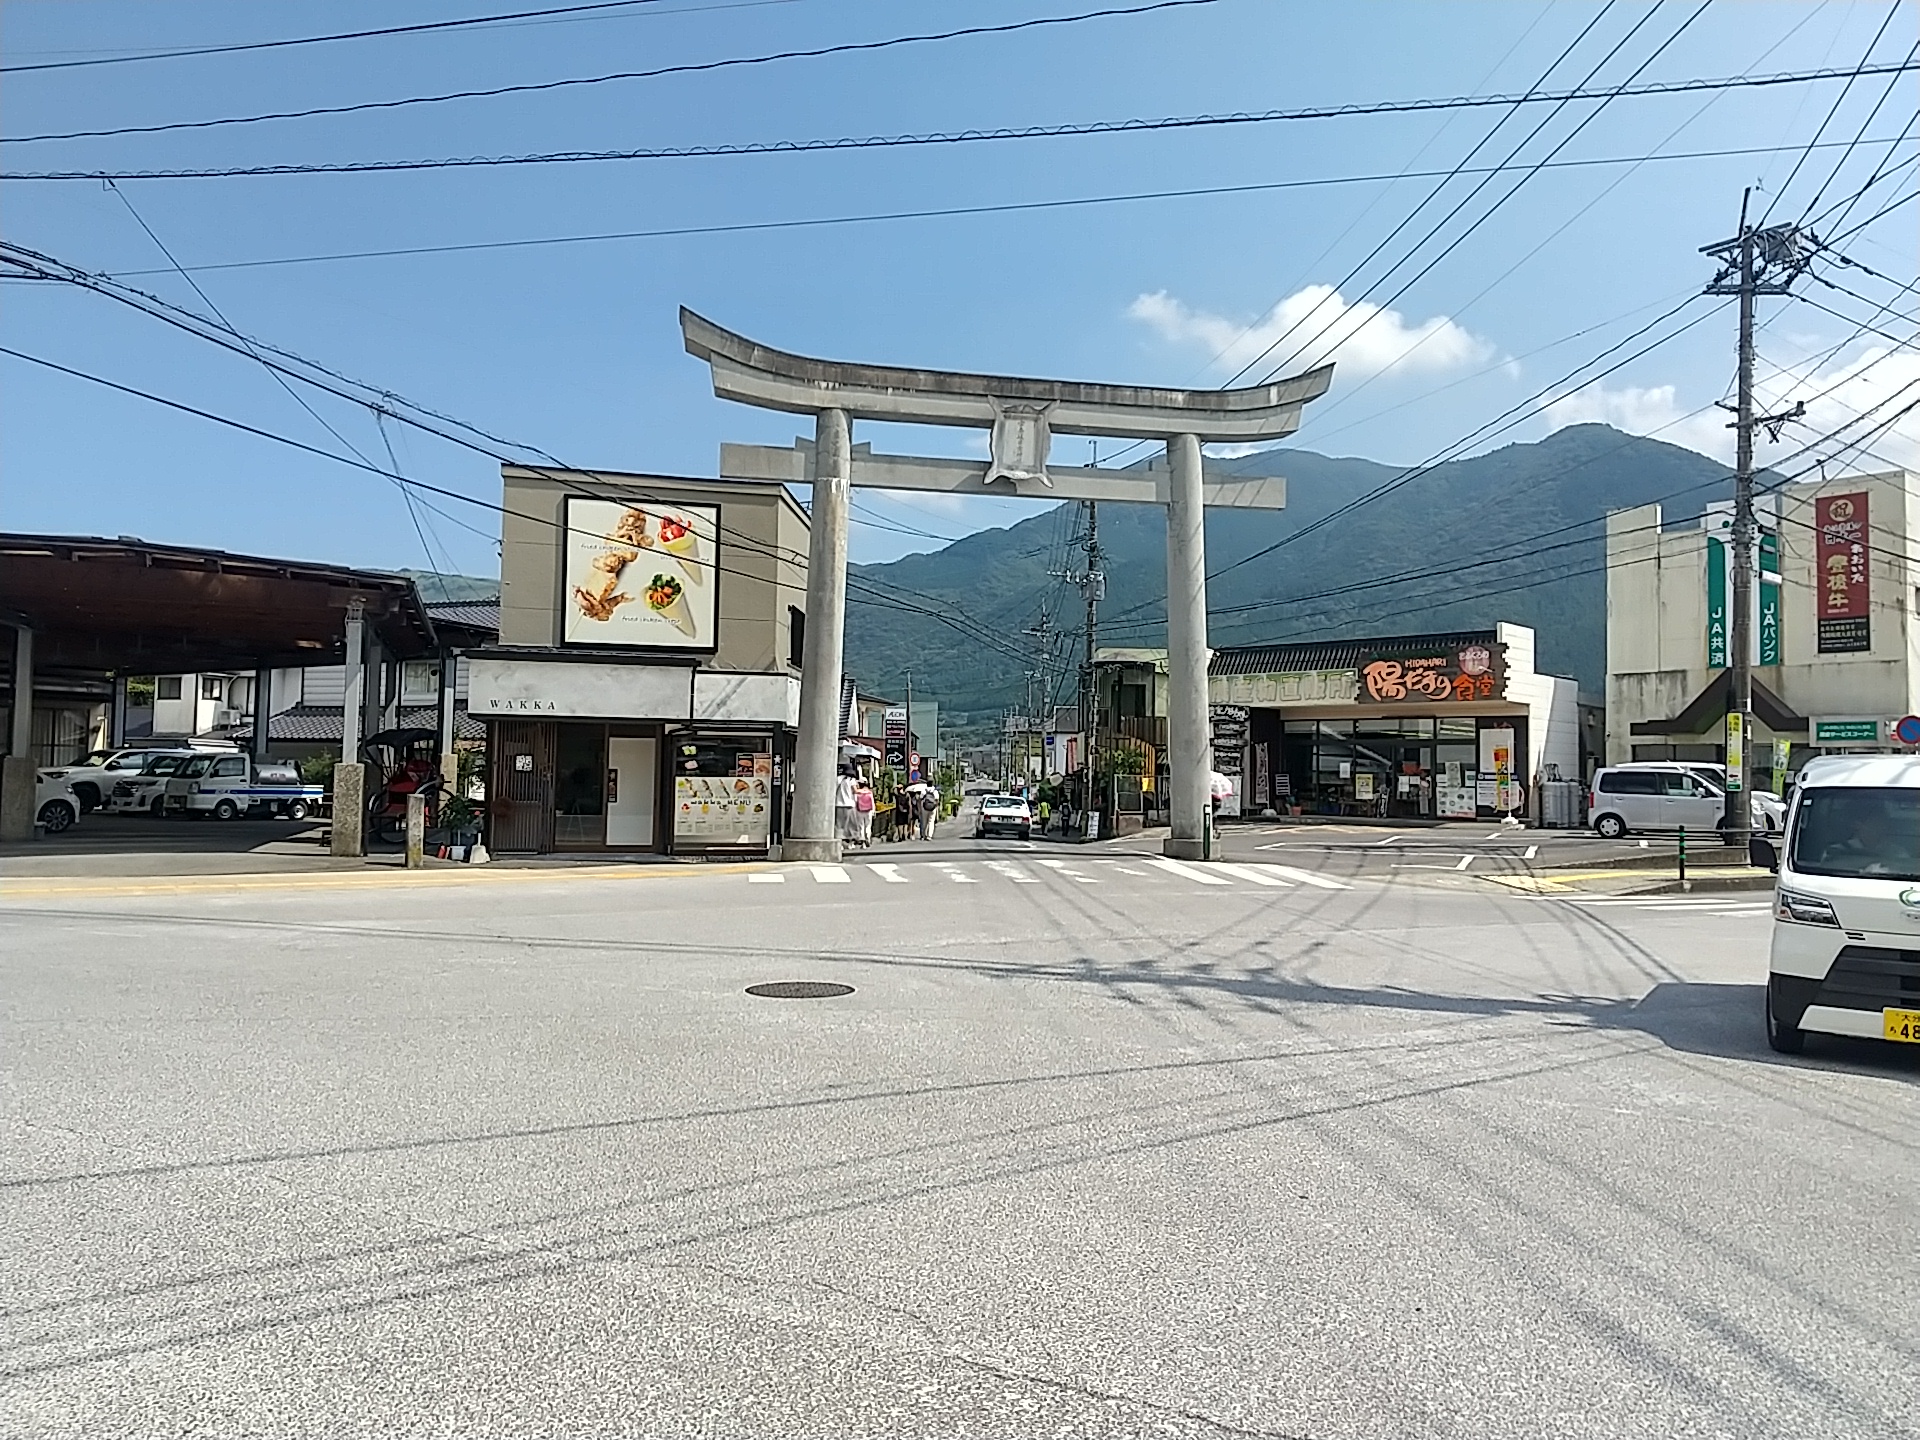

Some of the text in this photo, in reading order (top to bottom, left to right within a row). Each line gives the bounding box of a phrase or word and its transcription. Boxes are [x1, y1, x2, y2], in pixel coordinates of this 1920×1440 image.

[1829, 502, 1850, 519] 祝
[1826, 554, 1849, 607] 豊後牛
[1711, 606, 1724, 665] JA共済
[1763, 602, 1776, 662] JAバンク
[490, 699, 555, 710] WAKKA
